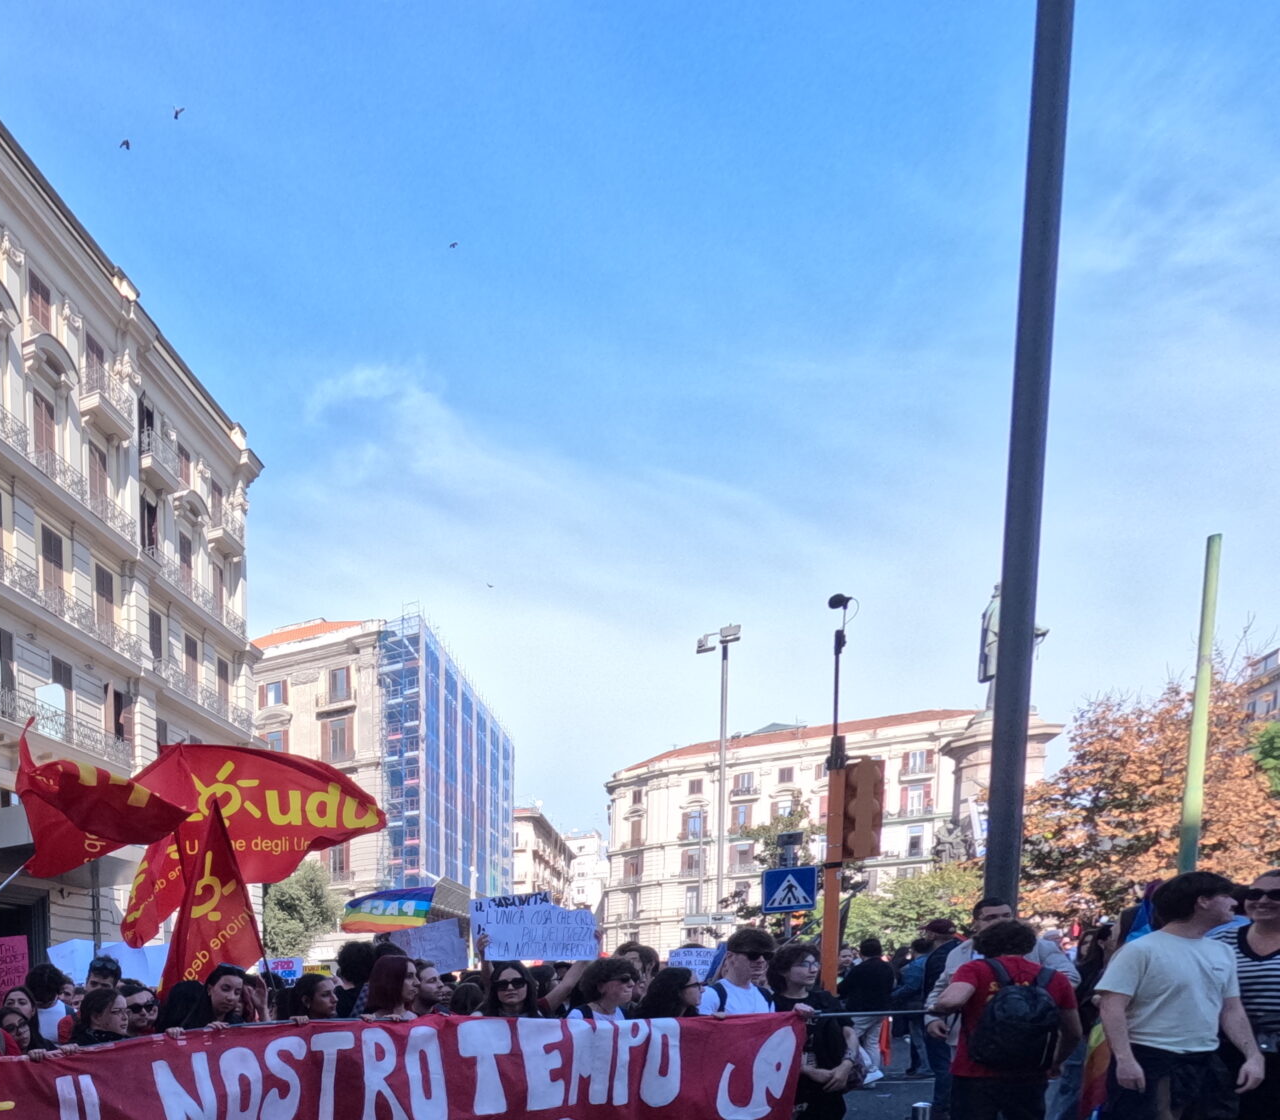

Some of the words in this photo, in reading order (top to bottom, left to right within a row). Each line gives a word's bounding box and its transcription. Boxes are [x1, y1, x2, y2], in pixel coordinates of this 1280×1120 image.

[265, 782, 380, 828] udu
[251, 836, 289, 855] degli
[457, 1017, 681, 1117] TEMPO
